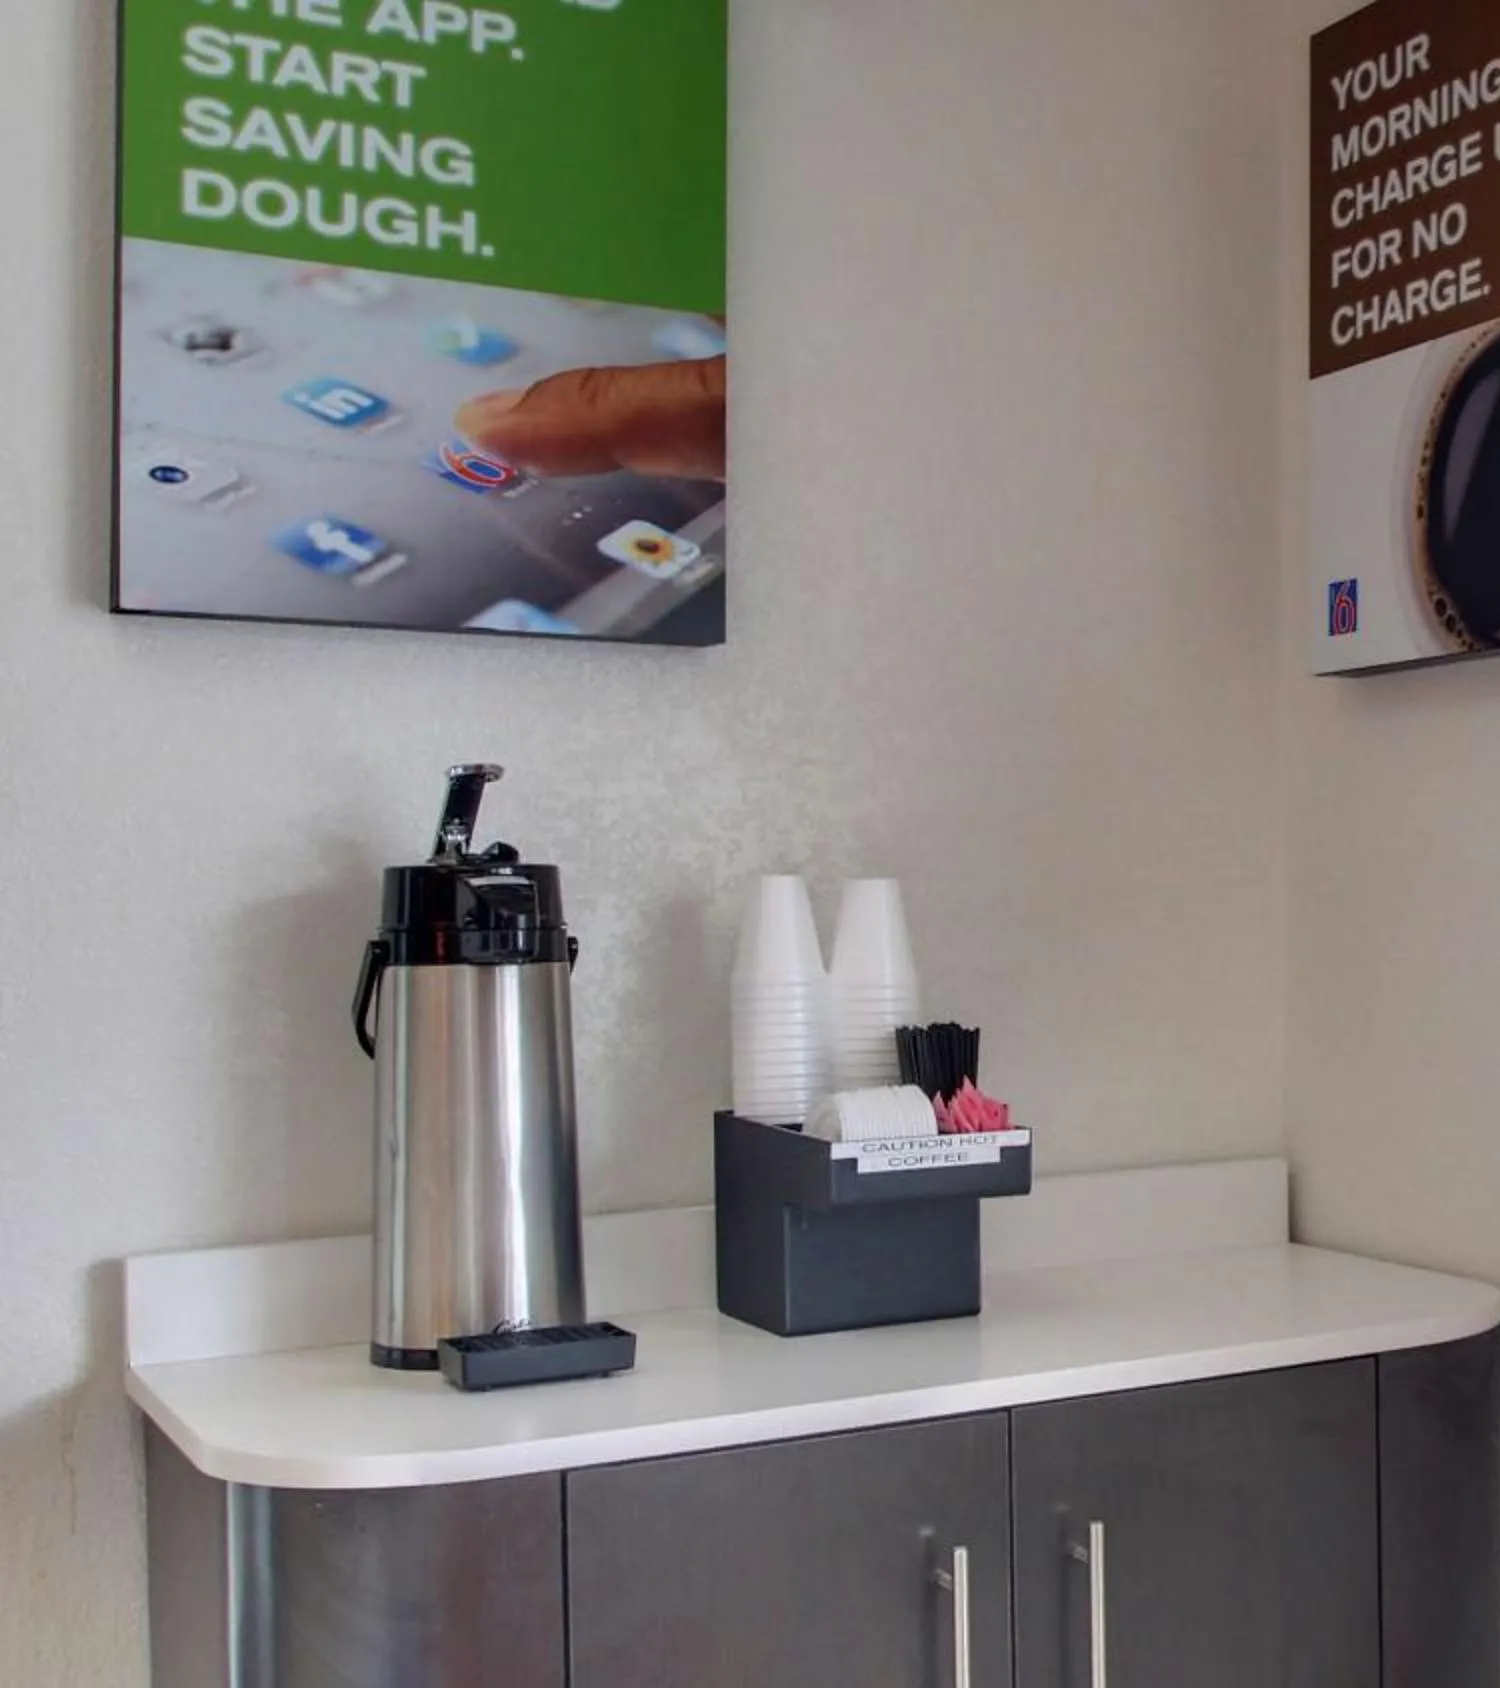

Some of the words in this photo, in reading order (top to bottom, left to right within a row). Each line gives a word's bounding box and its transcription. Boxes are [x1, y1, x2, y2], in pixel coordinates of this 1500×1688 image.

[181, 26, 427, 109] START
[367, 0, 524, 59] APP.
[1330, 33, 1431, 112] YOUR
[181, 97, 476, 187] SAVING
[1330, 131, 1484, 229] CHARGE
[181, 168, 496, 258] DOUGH.
[1330, 228, 1403, 289] FOR
[1411, 201, 1469, 259] NO
[1330, 258, 1492, 347] CHARGE.
[861, 1137, 953, 1153] CAUTION
[958, 1134, 998, 1146] HOT
[888, 1151, 969, 1167] COFFEE
